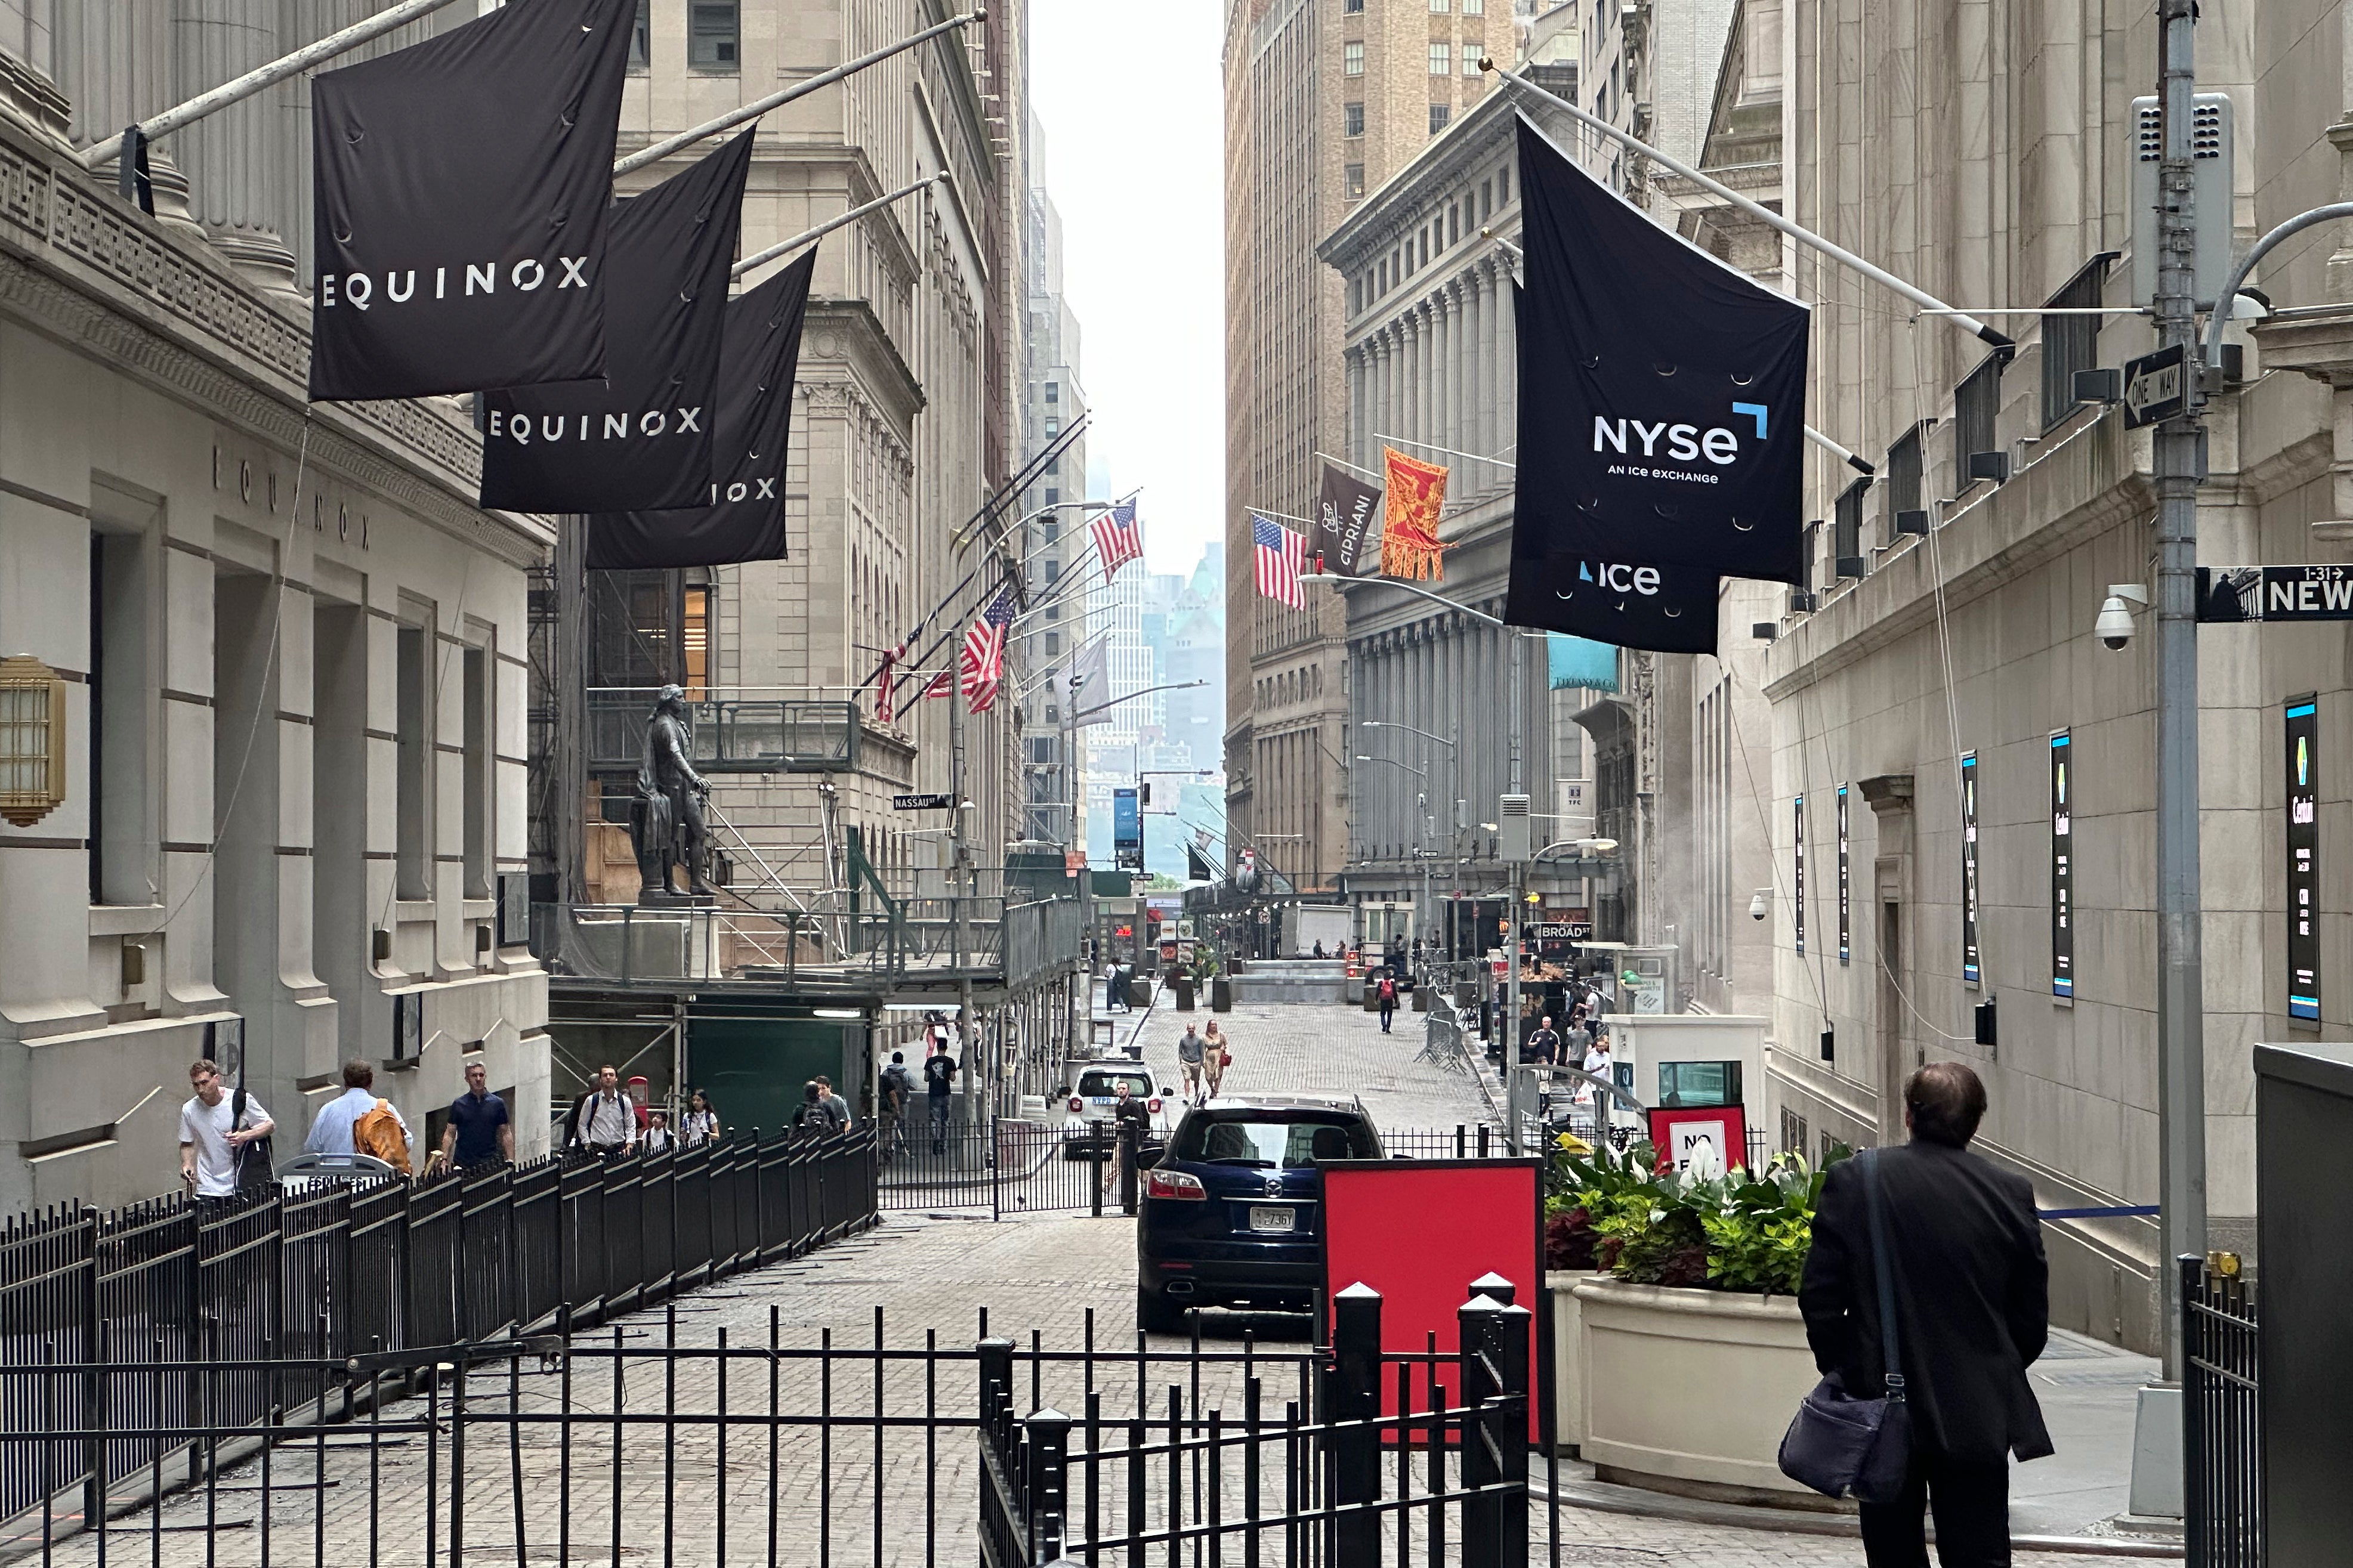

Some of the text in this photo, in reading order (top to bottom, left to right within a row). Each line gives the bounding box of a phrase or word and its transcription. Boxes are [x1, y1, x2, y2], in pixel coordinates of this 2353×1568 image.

[322, 256, 588, 311] EQUINOX
[2132, 368, 2176, 406] ONE WAY
[489, 407, 701, 445] EQUINOX
[1608, 465, 1625, 474] AN
[1340, 494, 1370, 565] CIPRIANI
[2304, 567, 2330, 581] 1-31
[2270, 580, 2353, 611] NEW
[895, 798, 929, 808] NASSAU
[1542, 927, 1582, 938] BROAD
